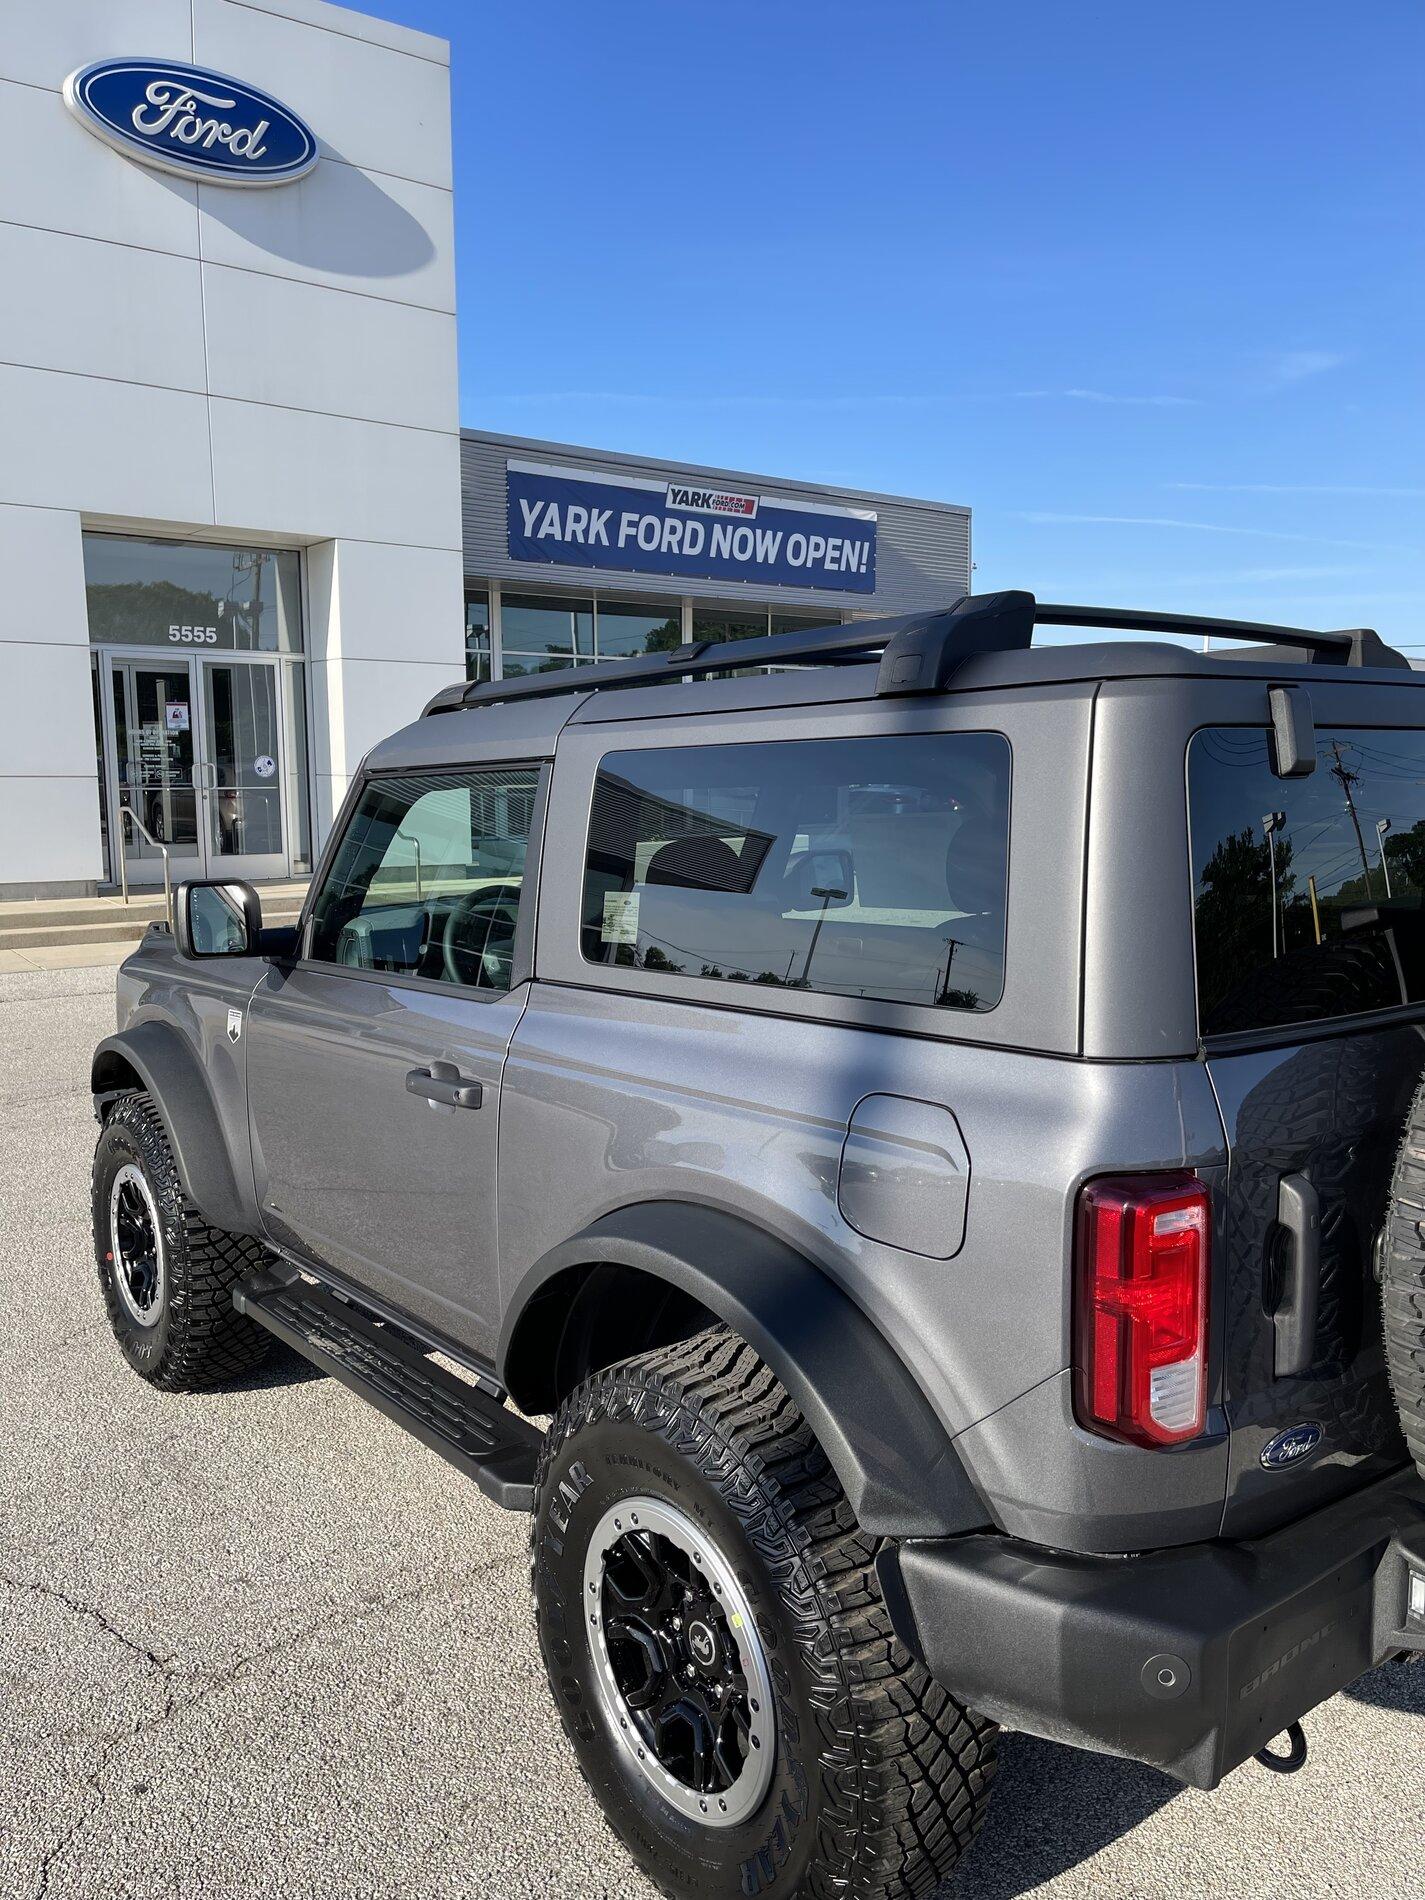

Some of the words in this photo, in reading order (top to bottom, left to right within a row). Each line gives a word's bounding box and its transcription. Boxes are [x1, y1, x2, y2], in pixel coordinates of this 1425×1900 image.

[131, 80, 269, 160] Ford
[671, 488, 713, 509] YARK
[712, 498, 746, 509] FORD.COM
[518, 498, 613, 547] YARK
[617, 512, 705, 556] FORD
[709, 522, 783, 564] NOW
[785, 532, 871, 573] OPEN!
[168, 625, 217, 643] 5555
[1278, 1434, 1316, 1461] Ford
